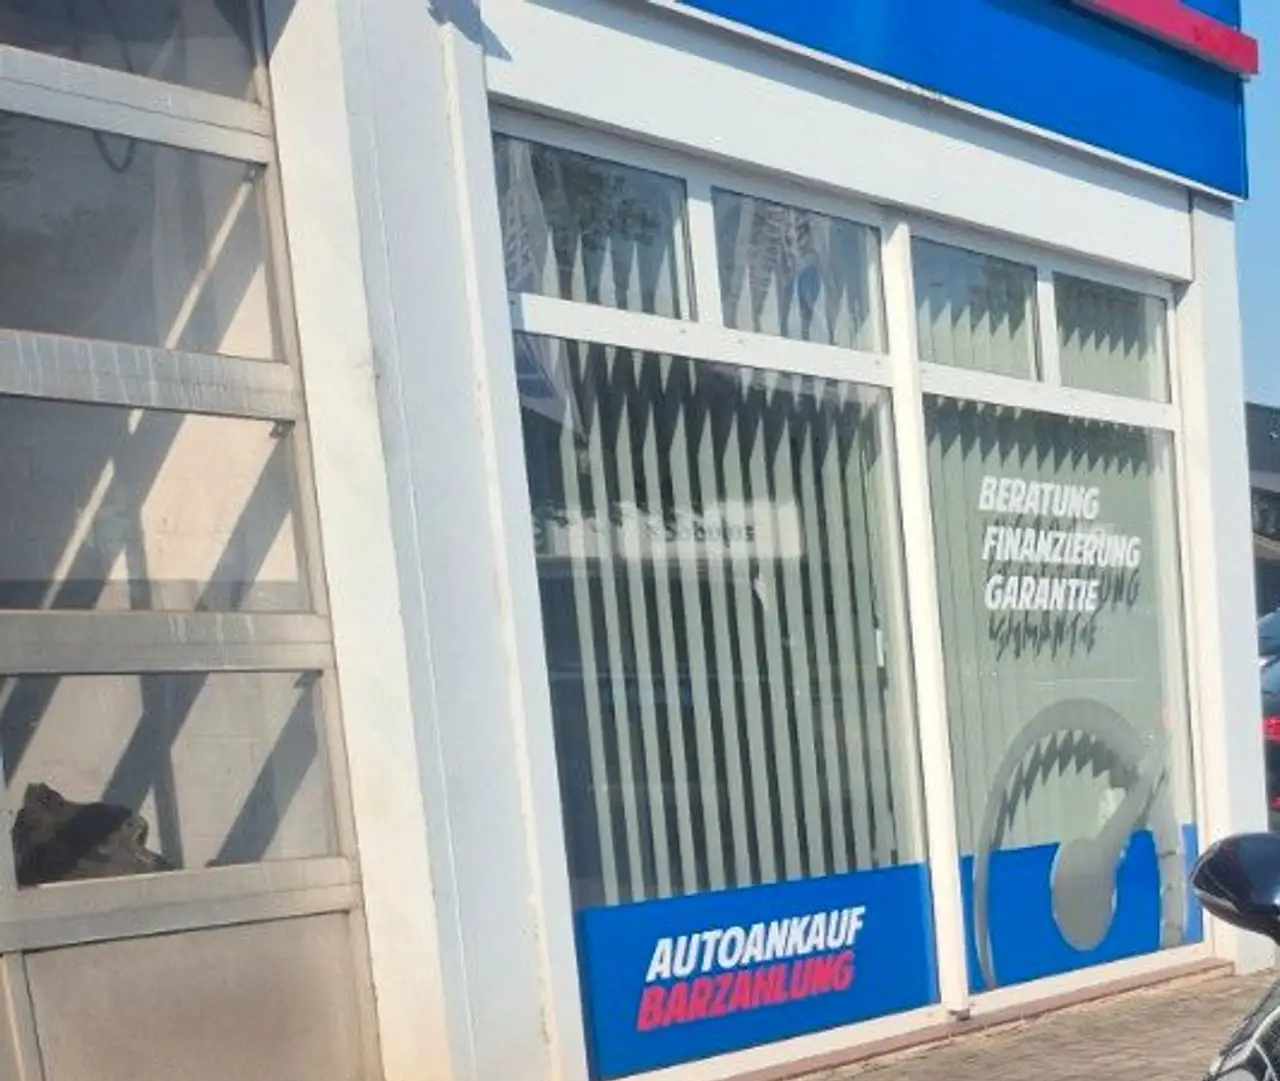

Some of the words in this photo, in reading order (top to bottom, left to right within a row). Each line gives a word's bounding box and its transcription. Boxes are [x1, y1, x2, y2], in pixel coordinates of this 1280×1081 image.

[978, 475, 1101, 520] BERATUNG
[981, 525, 1142, 568] FINANZIERUNG
[984, 574, 1100, 612] GARANTIE
[645, 905, 866, 983] AUTOANKAUF
[636, 950, 855, 1032] BARZAHLUNG
